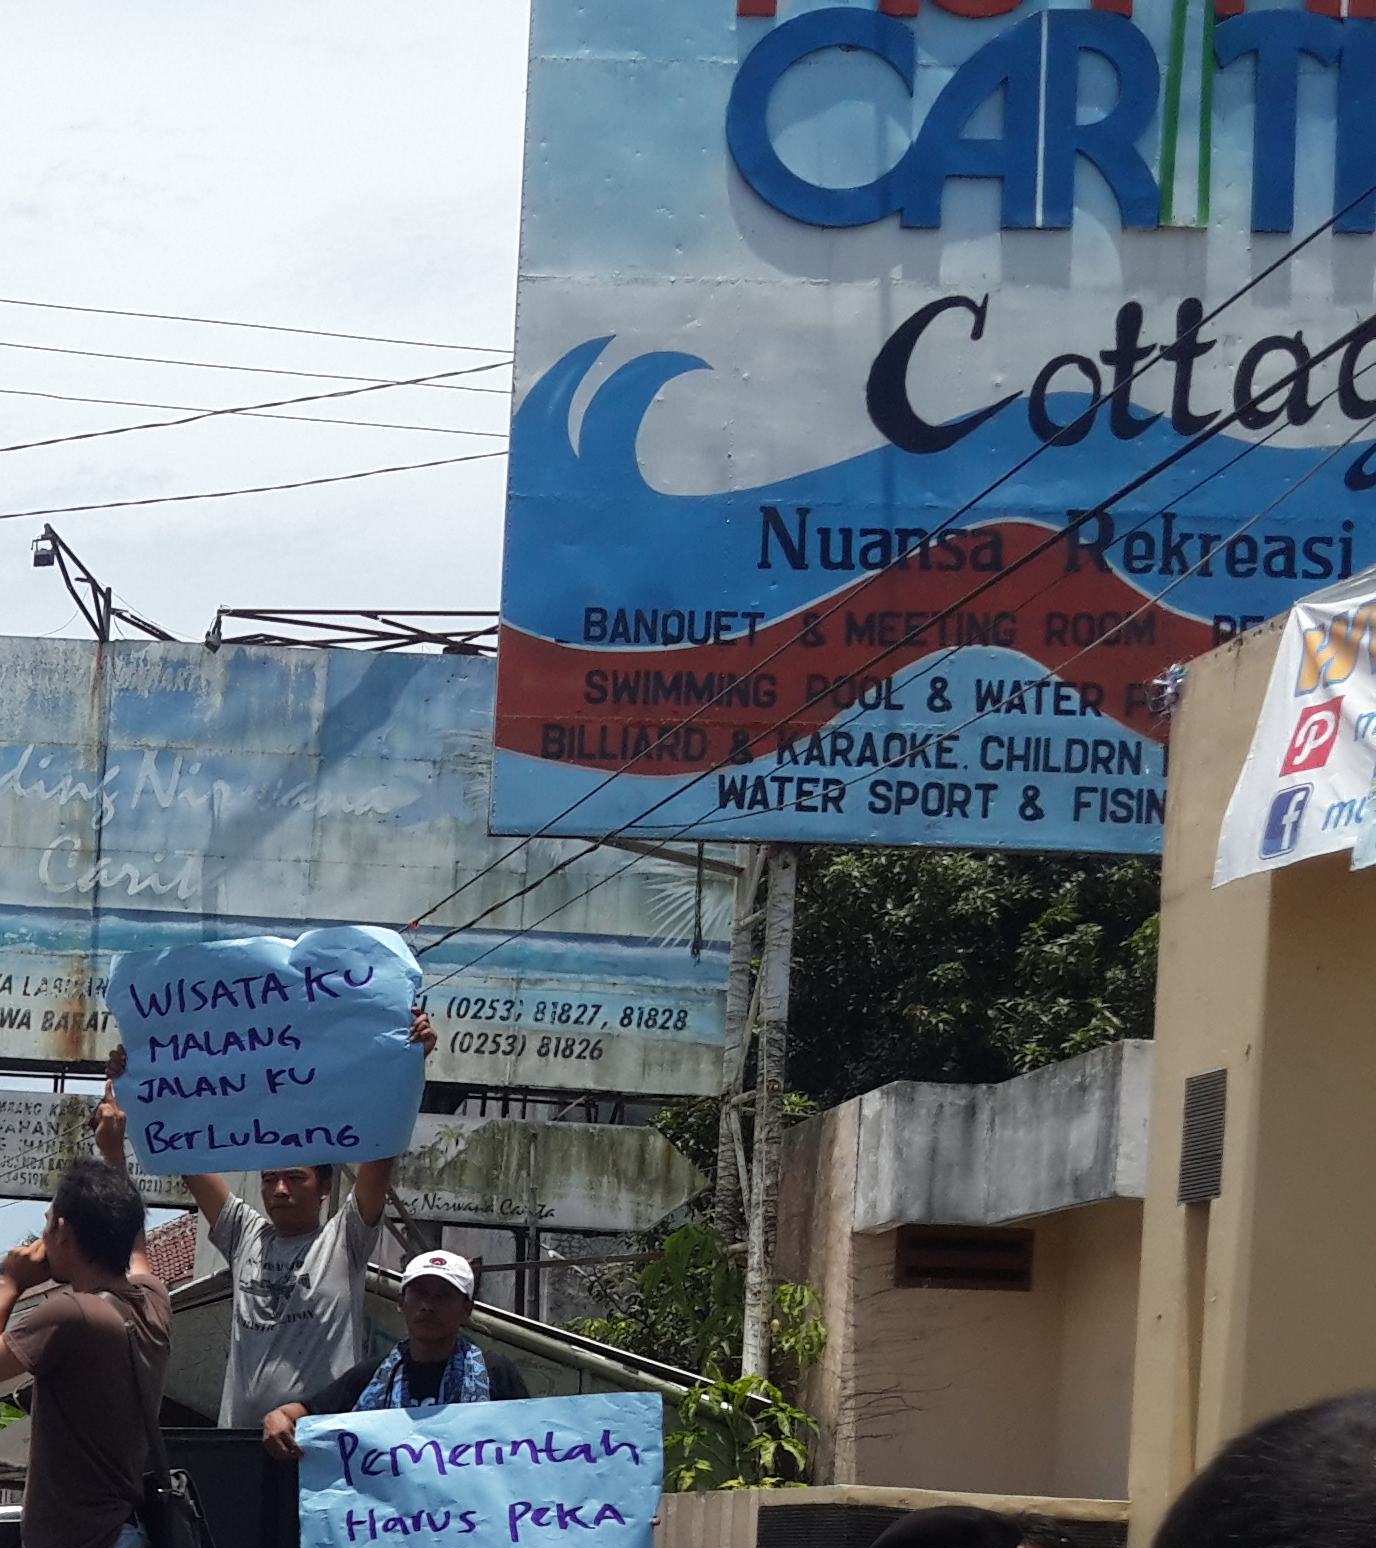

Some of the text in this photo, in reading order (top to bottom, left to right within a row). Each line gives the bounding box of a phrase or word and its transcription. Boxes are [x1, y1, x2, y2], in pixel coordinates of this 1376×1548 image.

[757, 505, 1354, 581] Nuansa Rekreasi
[583, 607, 765, 645] BANQUET
[800, 612, 826, 647] &
[846, 611, 1017, 648] MEETING
[1048, 611, 1156, 648] ROOM
[584, 669, 778, 708] SWIMMING
[806, 672, 904, 711] POOL
[927, 676, 952, 712] &
[975, 679, 1104, 717] WATER
[540, 724, 707, 762] BILLIARD
[730, 730, 754, 764] &
[979, 735, 1143, 776] CHILDRN
[718, 774, 846, 814] WATER
[868, 780, 998, 818] SPORT
[1019, 785, 1045, 821] &
[130, 966, 374, 1019] WISATA KU
[446, 996, 523, 1023] (0253)
[619, 1006, 688, 1031] 81828
[149, 1024, 301, 1063] MALANG
[450, 1031, 604, 1061] (0253) 81826
[137, 1067, 315, 1104] JALAN KU
